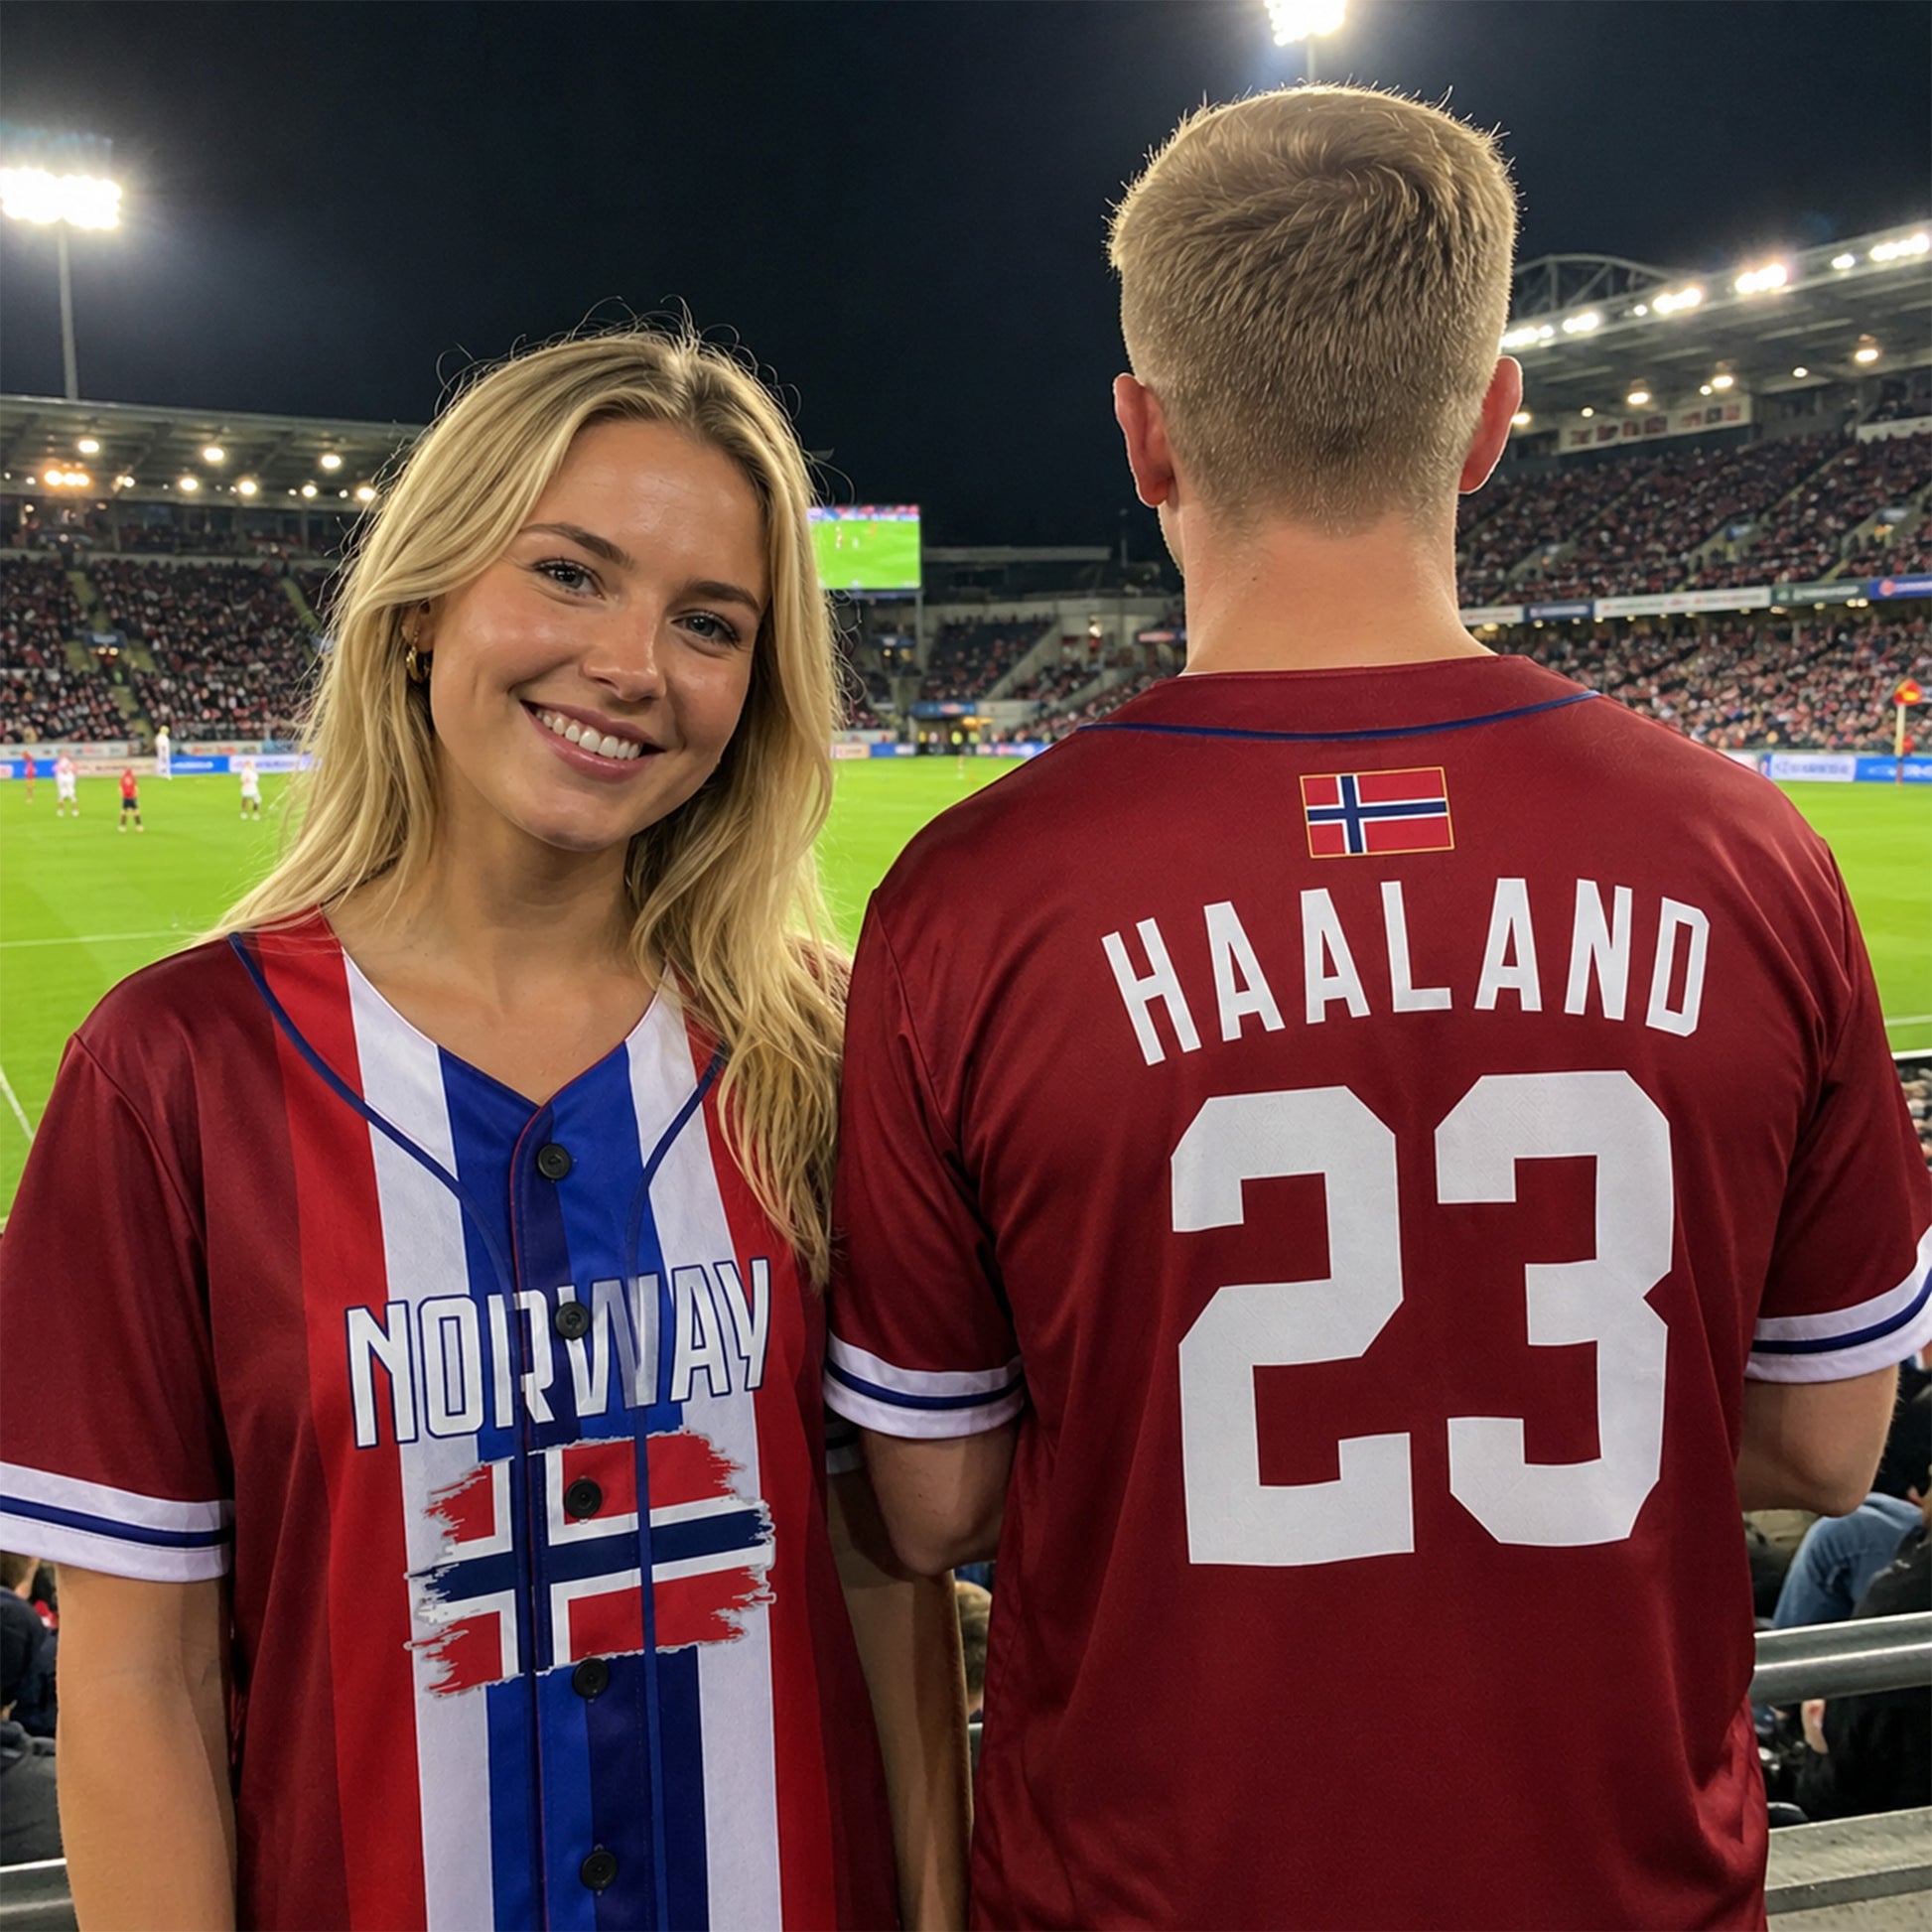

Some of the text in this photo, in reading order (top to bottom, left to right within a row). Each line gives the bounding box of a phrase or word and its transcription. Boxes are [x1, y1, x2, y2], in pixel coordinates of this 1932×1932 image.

[1101, 878, 1710, 1065] HAALAND
[345, 1257, 770, 1449] NORWAY
[1171, 1070, 1675, 1567] 23
